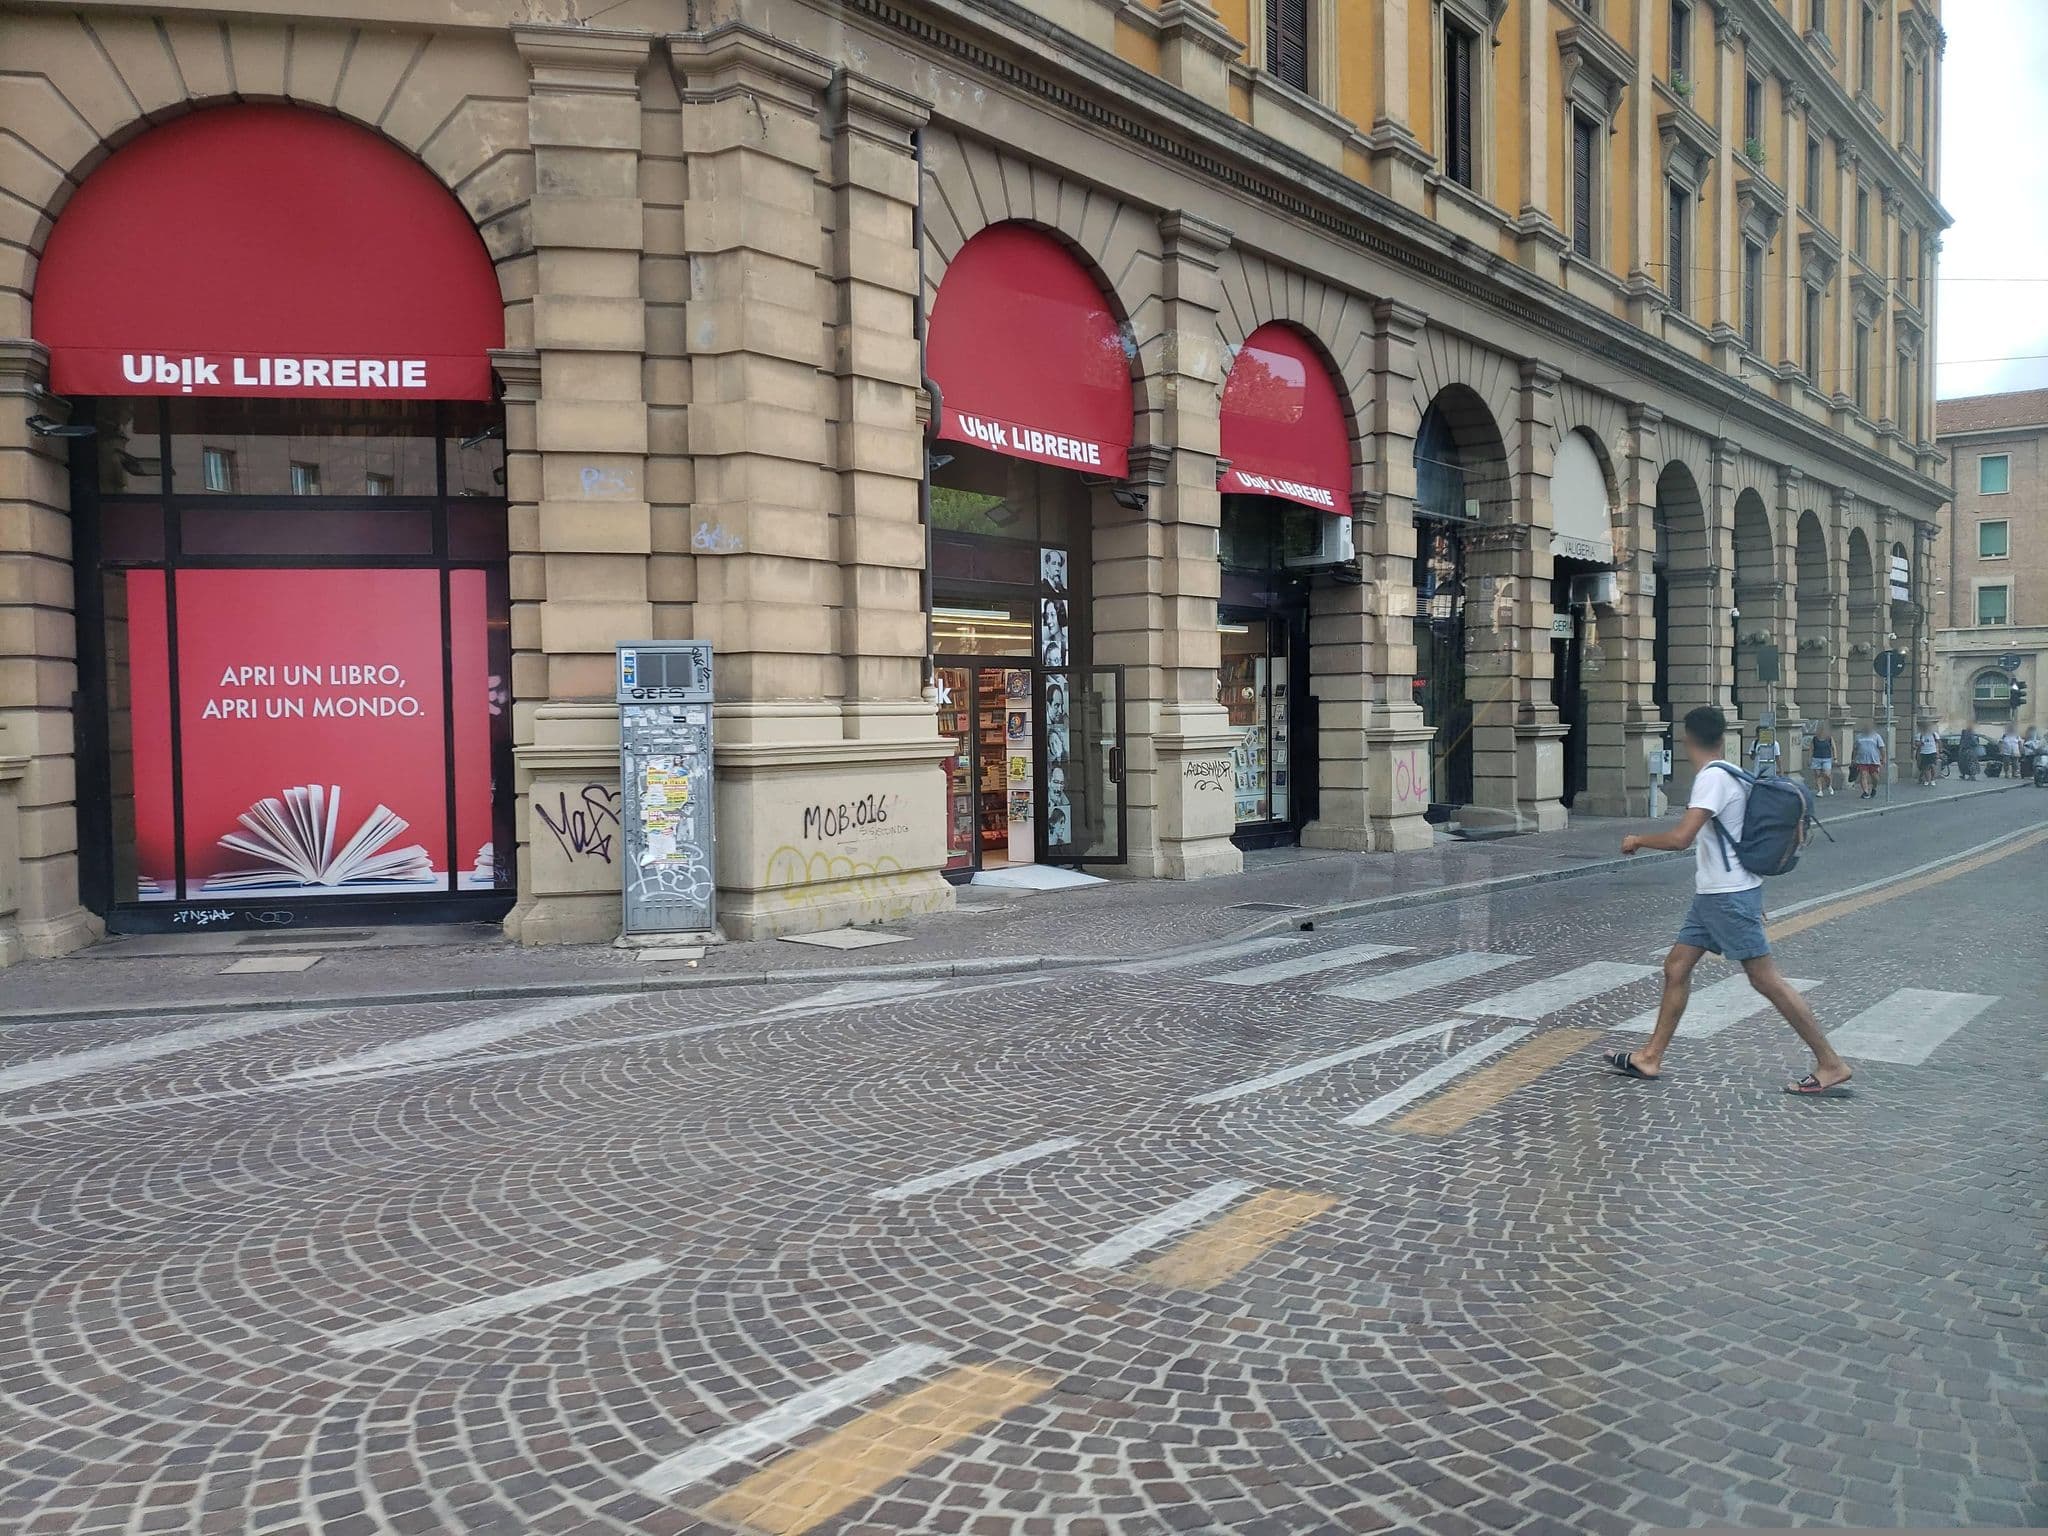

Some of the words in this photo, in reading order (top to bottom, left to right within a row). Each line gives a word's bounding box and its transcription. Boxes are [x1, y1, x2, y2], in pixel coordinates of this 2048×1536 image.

[122, 354, 220, 393] Ubik
[233, 358, 427, 387] LIBRERIE
[958, 414, 1008, 450] Ubik
[1012, 427, 1101, 465] LIBRERIE
[1270, 479, 1335, 506] LIBRERIE
[220, 666, 275, 687] APRI
[284, 665, 322, 686] UN
[330, 664, 406, 688] LIBRO,
[202, 698, 257, 719] APRI
[265, 698, 304, 719] UN
[312, 696, 425, 718] MONDO.
